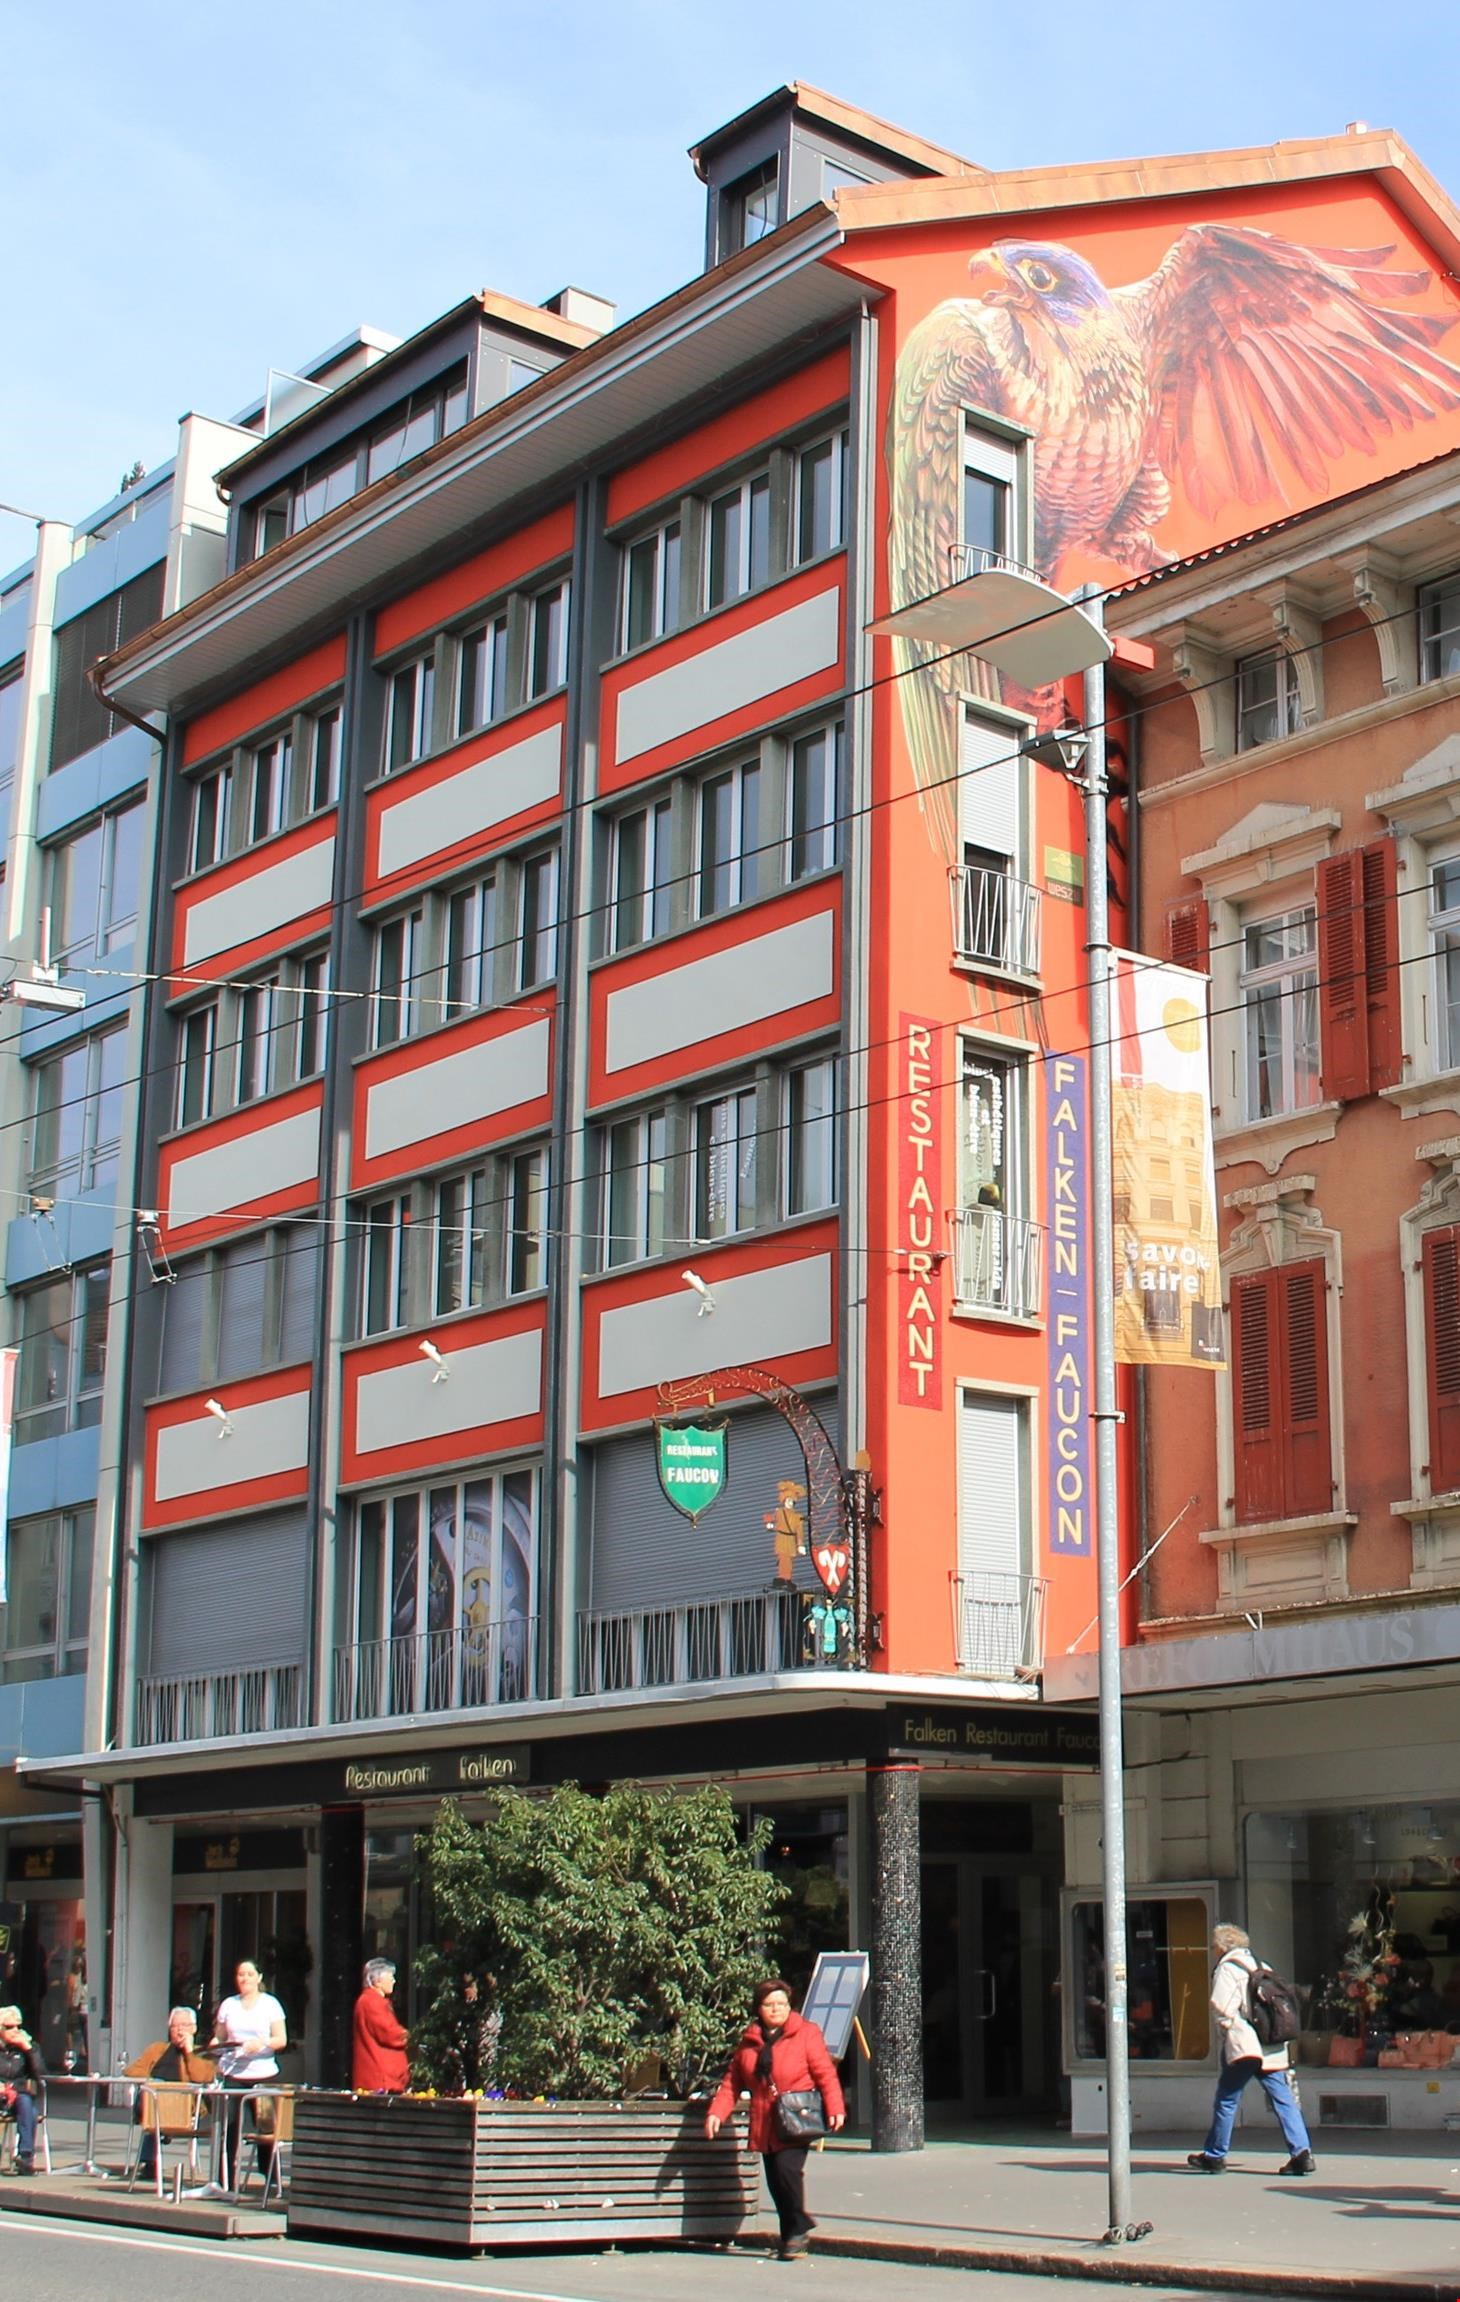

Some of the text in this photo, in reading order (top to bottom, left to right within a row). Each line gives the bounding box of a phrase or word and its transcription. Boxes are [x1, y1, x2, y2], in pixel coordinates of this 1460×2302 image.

[908, 1027, 935, 1398] RESTAURANT
[1053, 1061, 1078, 1277] FALKEN
[1055, 1315, 1083, 1546] FAUCON
[345, 1753, 515, 1790] Restaurant Falken
[904, 1717, 957, 1743] Falken
[966, 1722, 1048, 1747] Restaurant
